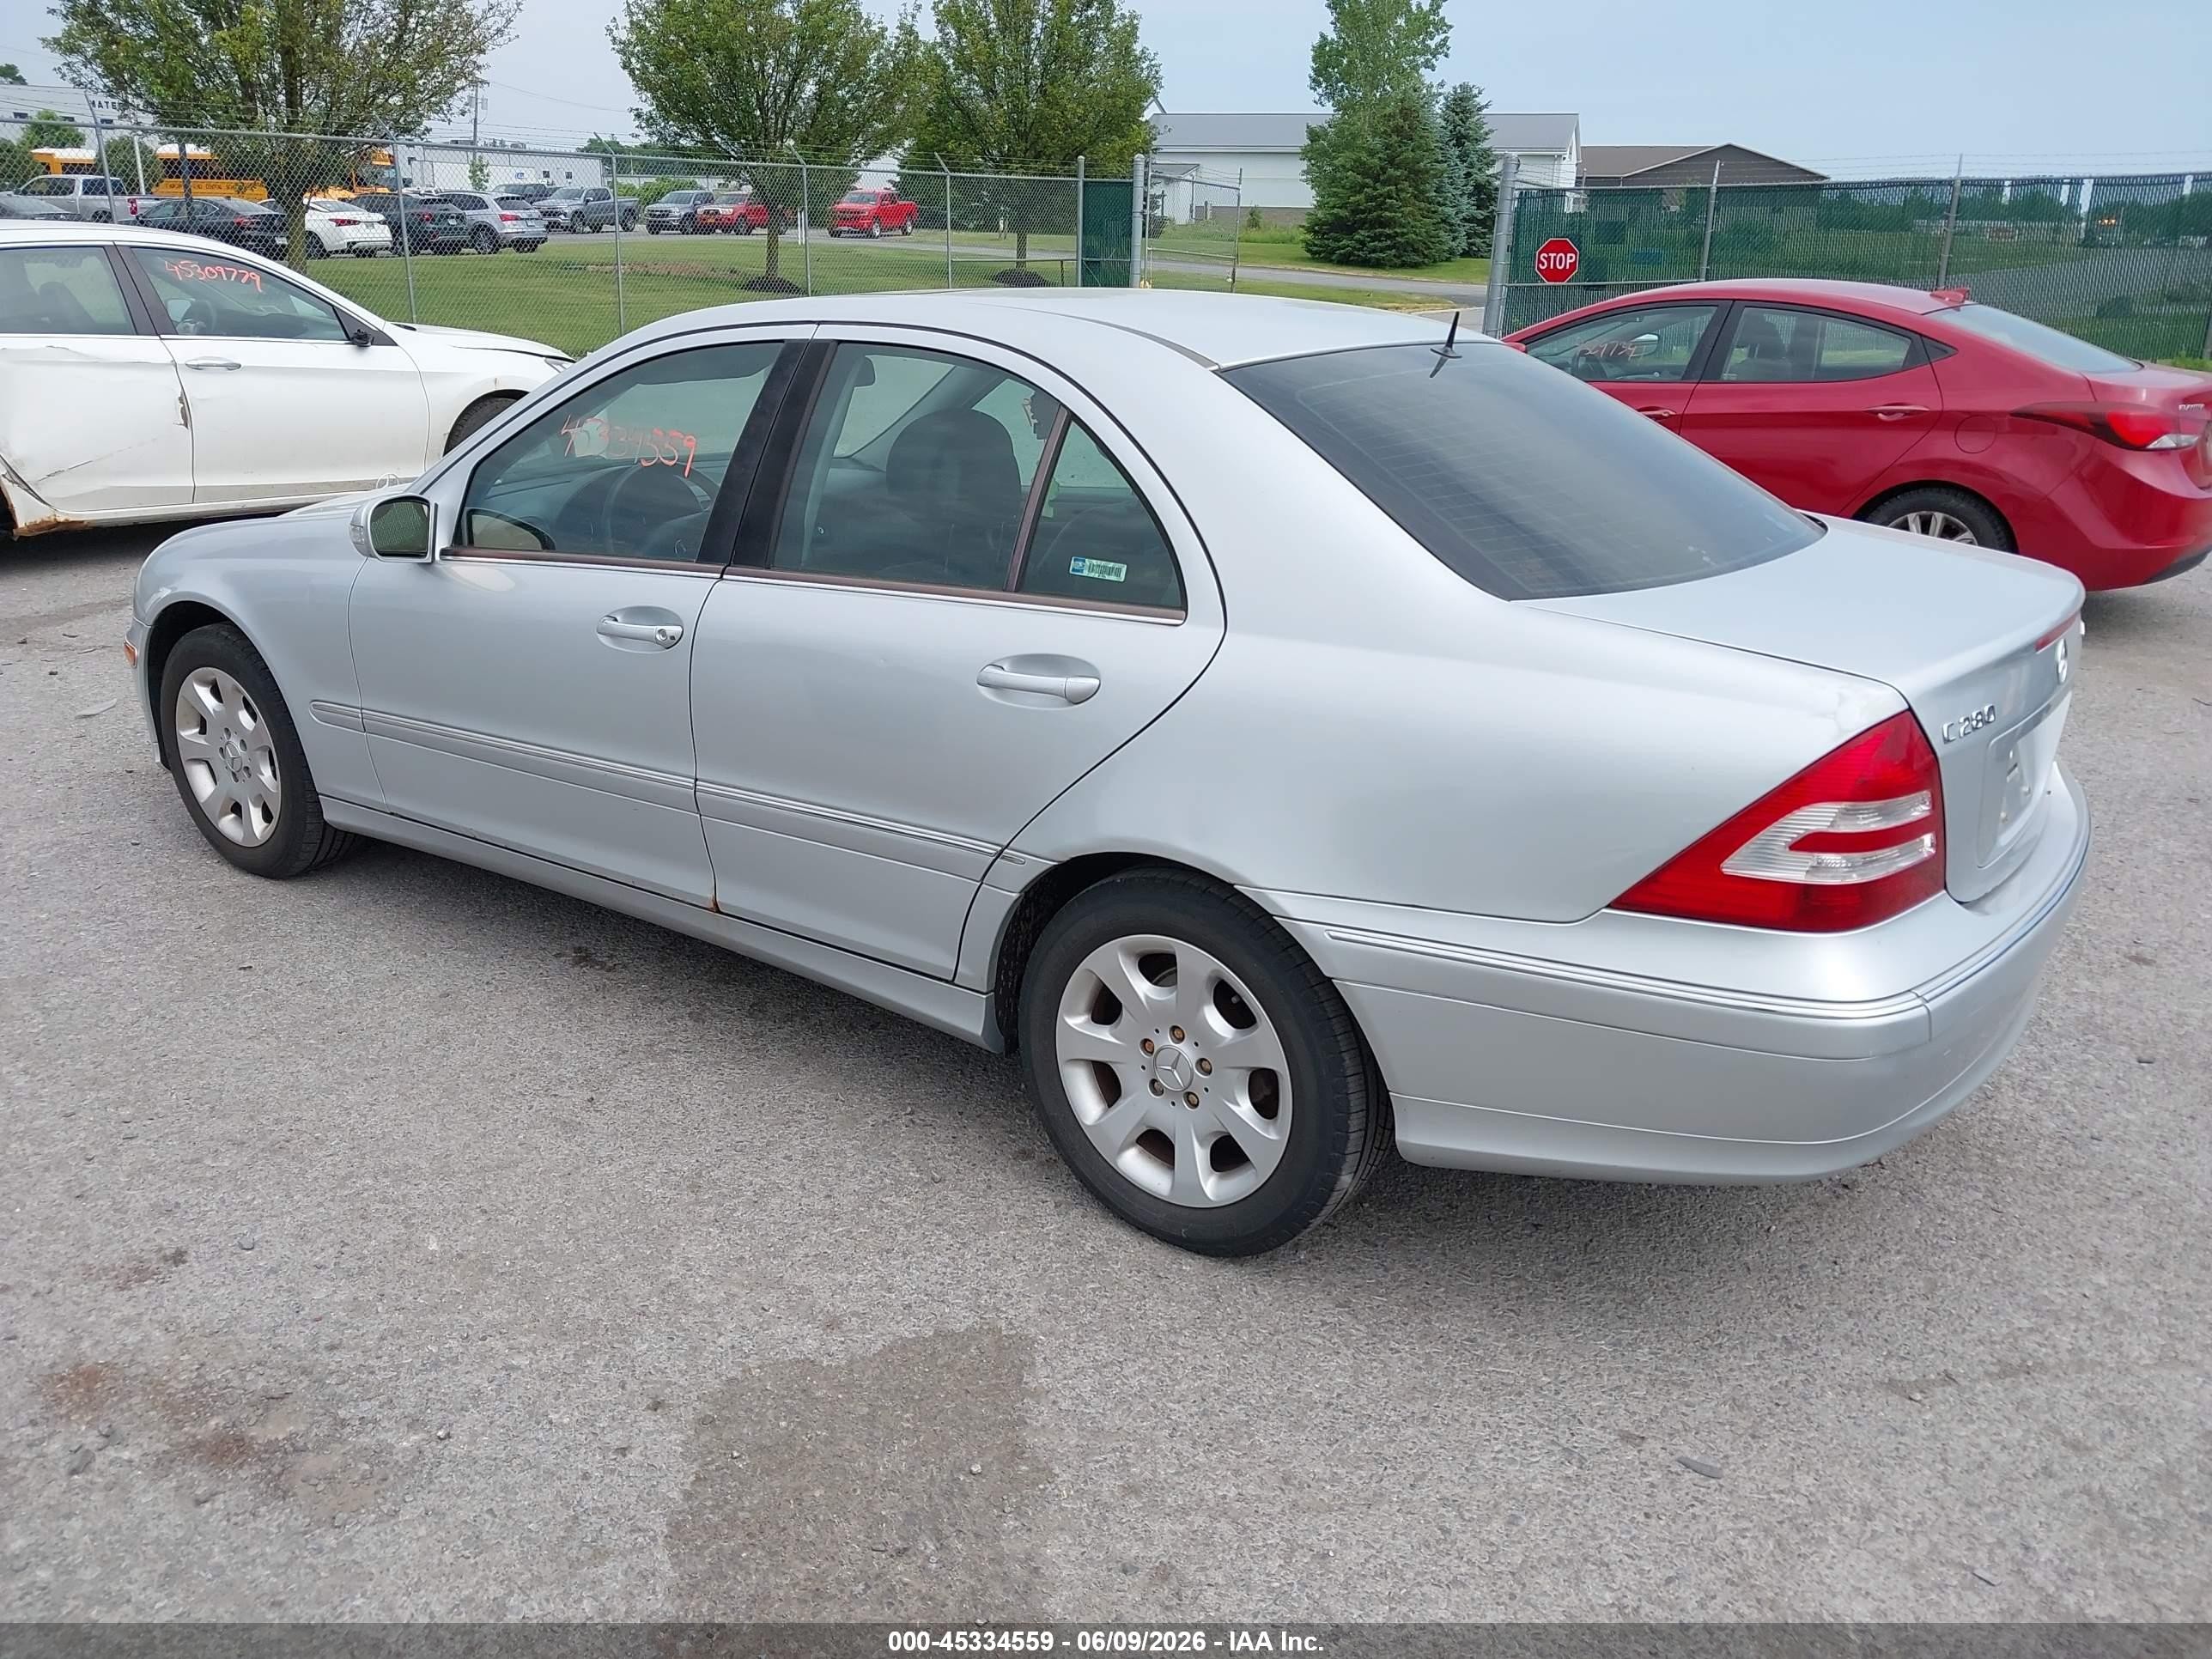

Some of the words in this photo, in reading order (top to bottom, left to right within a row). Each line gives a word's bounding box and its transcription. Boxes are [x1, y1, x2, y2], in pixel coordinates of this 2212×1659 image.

[165, 260, 262, 293] 45309779
[1539, 252, 1576, 270] STOP
[1942, 721, 1957, 744] C
[1959, 704, 1996, 738] 280
